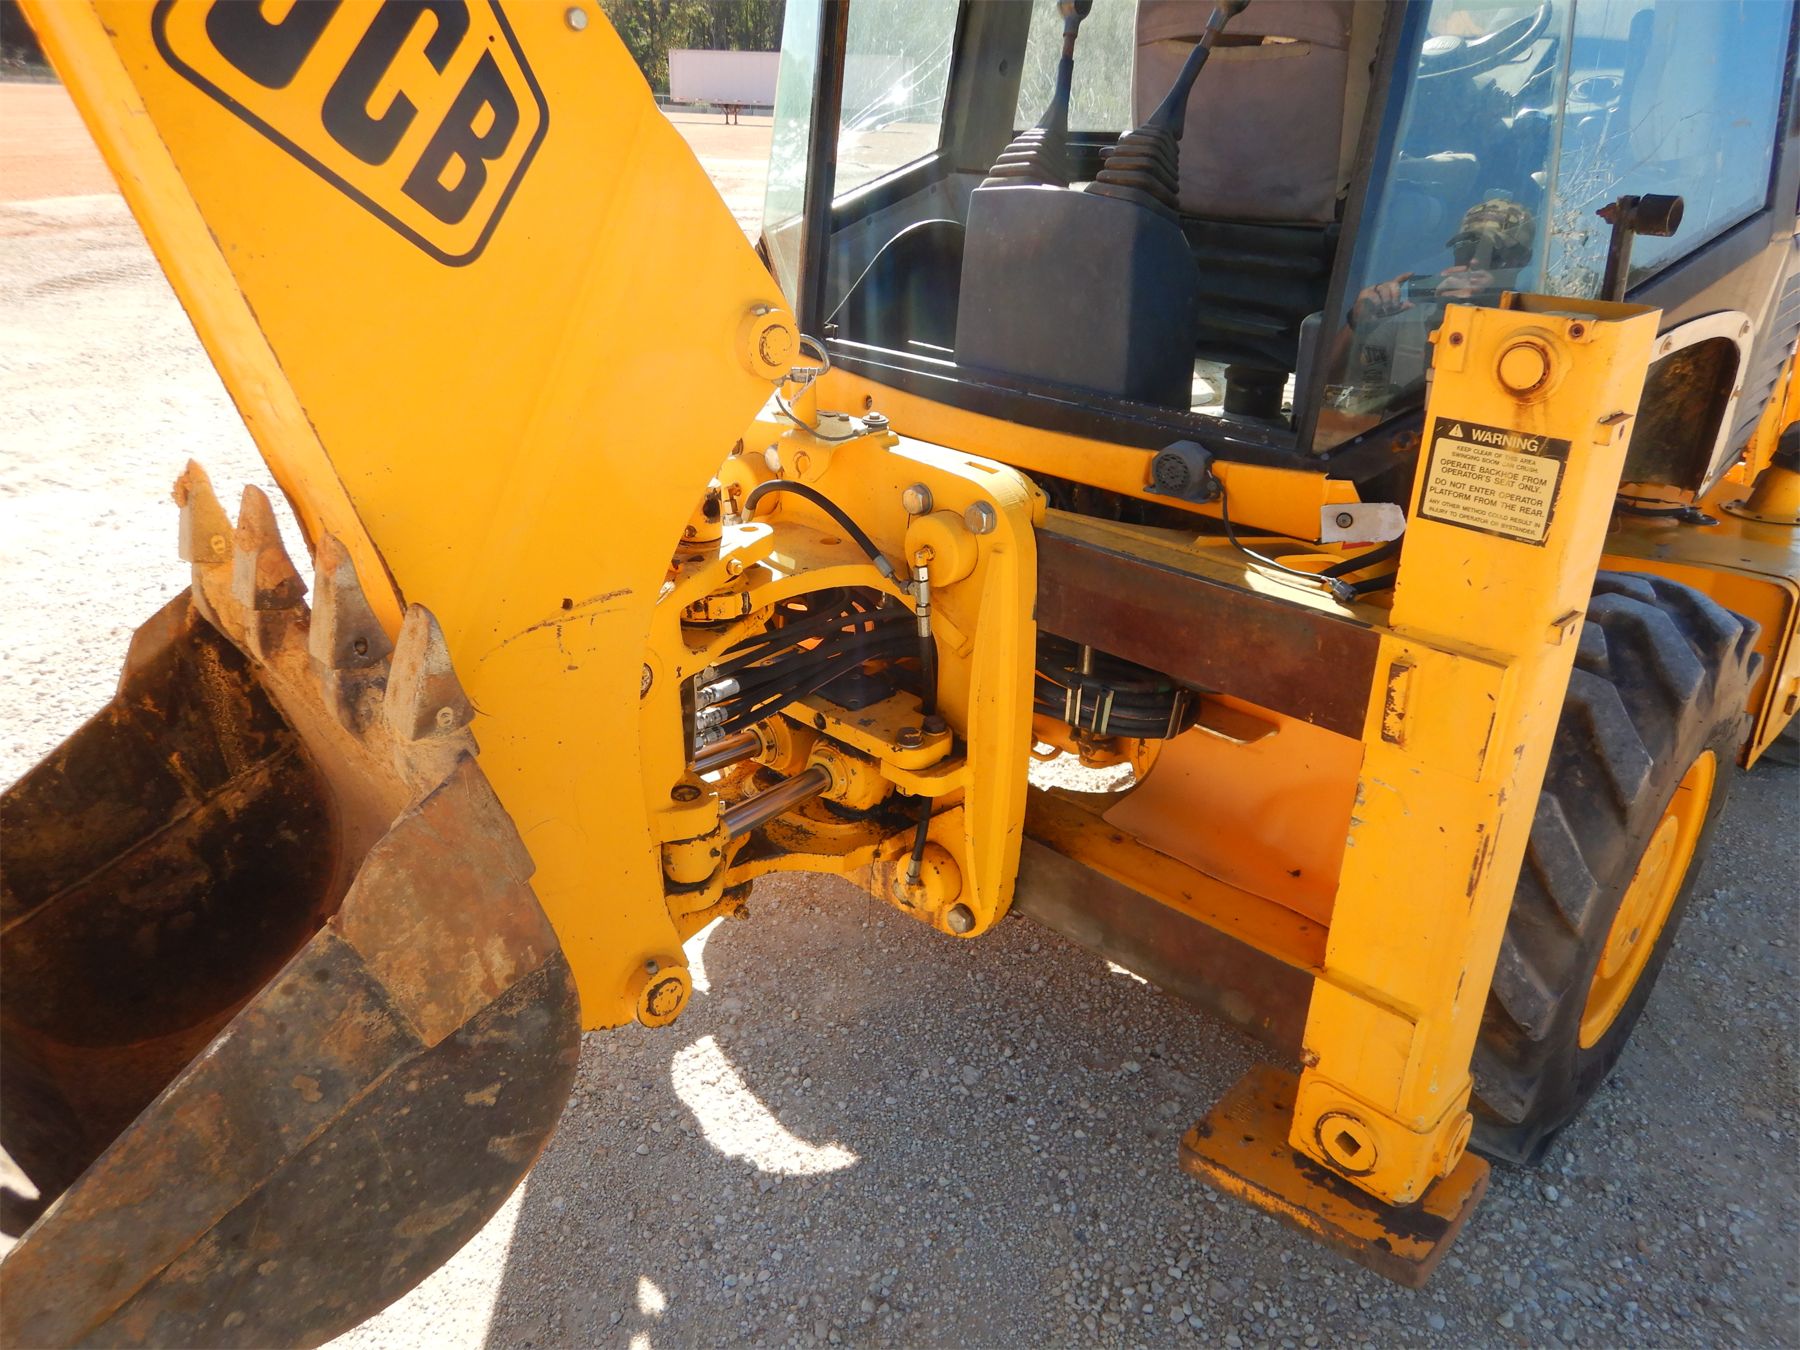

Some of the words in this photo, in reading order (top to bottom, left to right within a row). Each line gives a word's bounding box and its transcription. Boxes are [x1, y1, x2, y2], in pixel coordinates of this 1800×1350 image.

[1471, 429, 1539, 452] WARNING
[1473, 448, 1492, 456] CLEAR
[1451, 451, 1480, 462] SWINGING
[1482, 457, 1500, 465] BOOM
[1440, 458, 1476, 471] OPERATE
[1479, 466, 1519, 480] BACKHOE
[1522, 475, 1547, 486] FROM
[1441, 466, 1491, 483] OPERATOR'S
[1494, 477, 1515, 488] SEAT
[1518, 482, 1541, 494] ONLY.
[1429, 486, 1471, 501] PLATFORM
[1474, 496, 1497, 507] FROM
[1501, 501, 1517, 512] THE
[1519, 506, 1545, 518] REAR.
[1435, 477, 1447, 486] DO
[1450, 481, 1466, 490] NOT
[1469, 485, 1496, 497] ENTER
[1498, 491, 1543, 507] OPERATOR
[1429, 506, 1448, 514] INJURY
[1459, 513, 1488, 524] OPERATOR
[1441, 501, 1460, 509] OTHER
[1462, 506, 1486, 516] METHOD
[1488, 511, 1508, 520] COULD
[1510, 516, 1532, 526] RESULT
